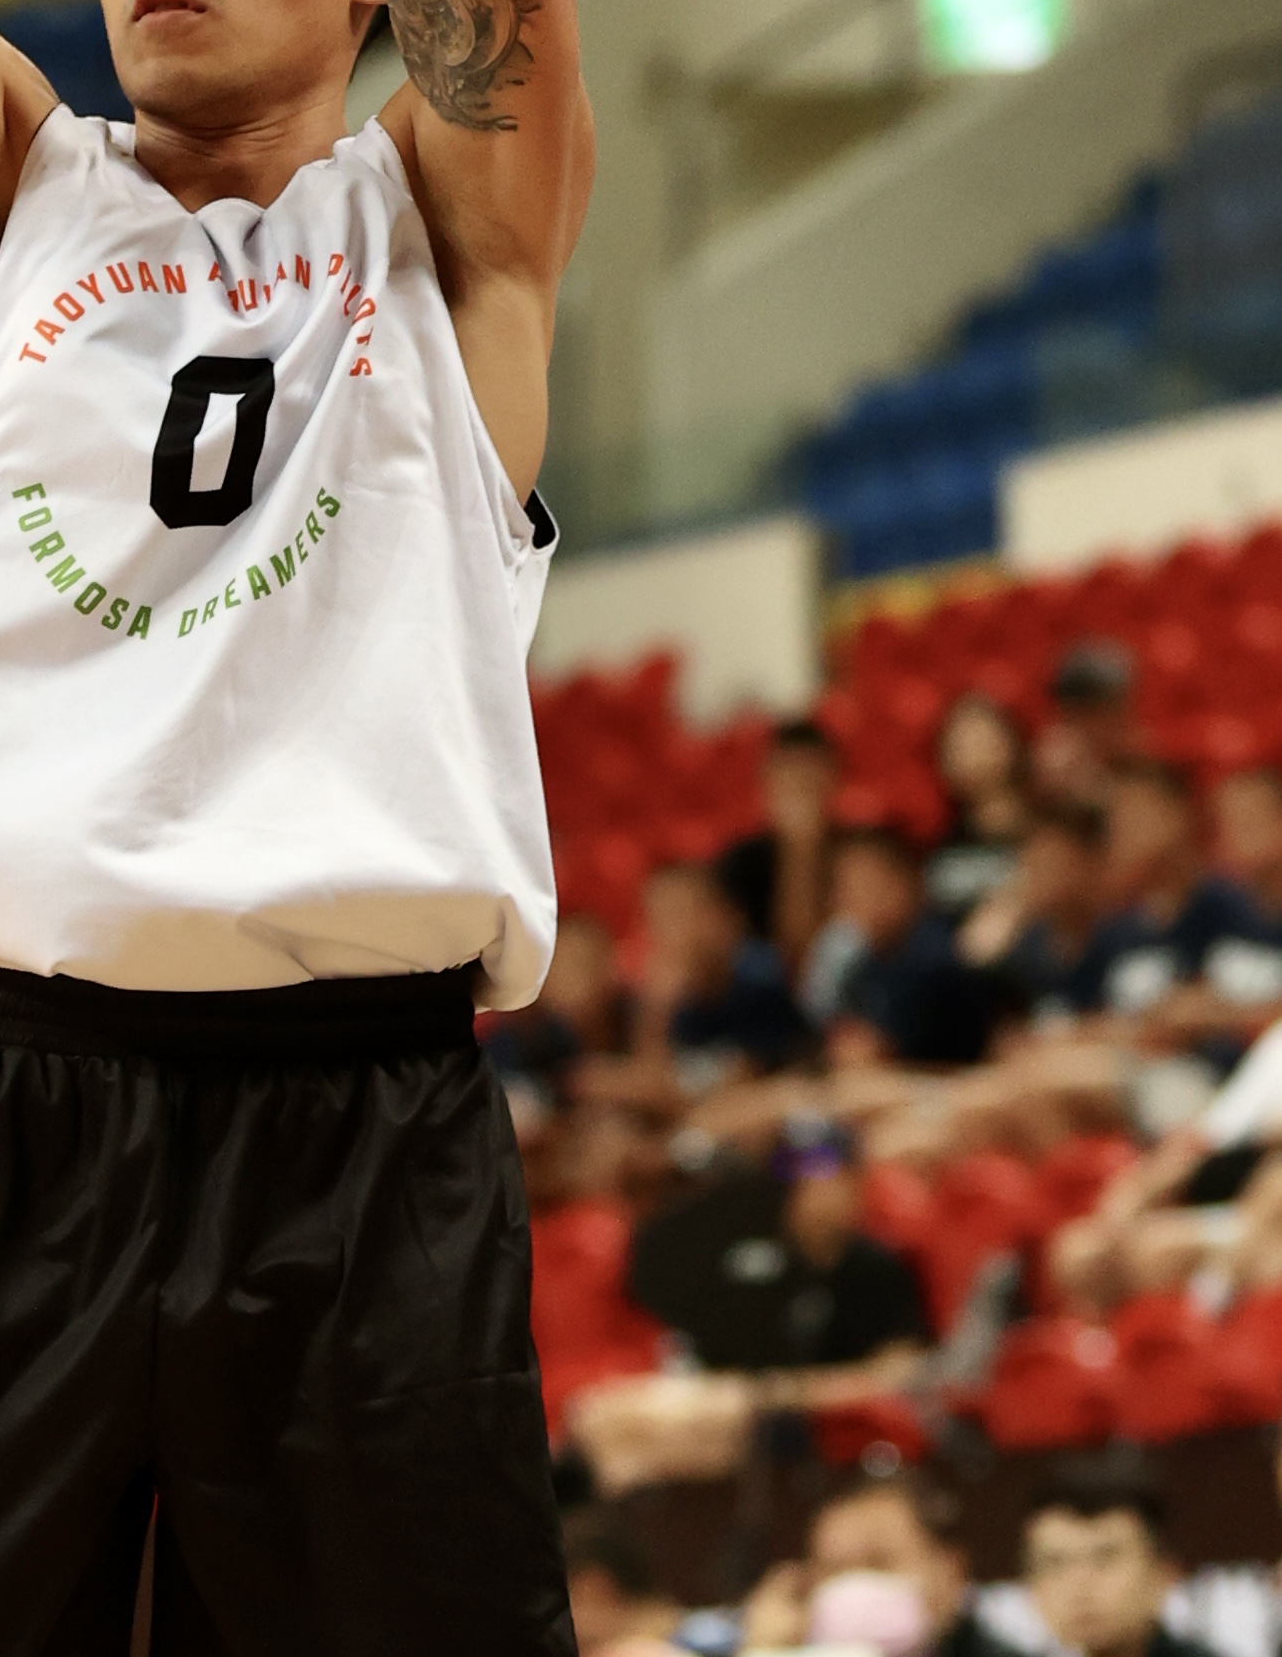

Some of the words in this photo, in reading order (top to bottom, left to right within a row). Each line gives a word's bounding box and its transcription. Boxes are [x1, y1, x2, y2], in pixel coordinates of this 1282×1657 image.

[18, 260, 187, 364] TAOYUAN
[150, 355, 275, 529] 0
[11, 482, 153, 640] FORMOSA
[176, 487, 341, 639] DREAMERS
